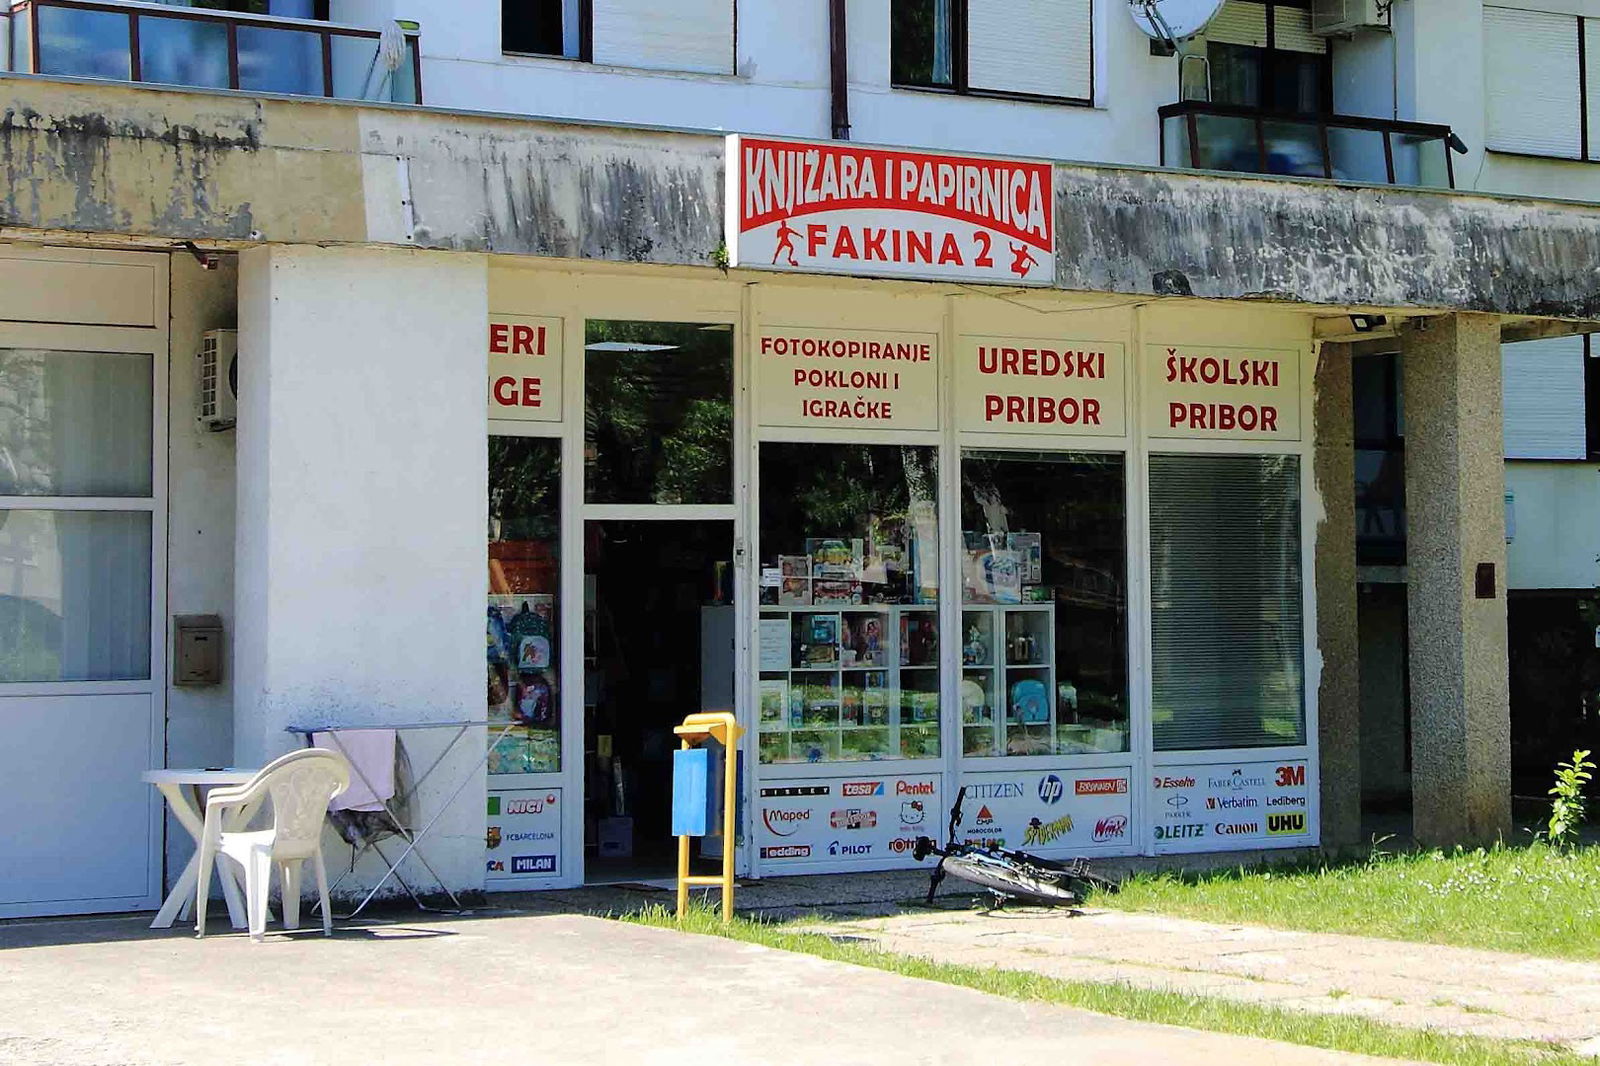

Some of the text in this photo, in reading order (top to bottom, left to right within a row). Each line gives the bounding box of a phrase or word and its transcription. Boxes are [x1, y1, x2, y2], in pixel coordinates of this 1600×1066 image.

[746, 147, 1048, 240] KNJIŽARA I PAPIRNICA
[807, 224, 993, 268] FAKINA 2
[489, 324, 546, 355] ERI
[761, 337, 931, 363] FOTOKOPIRANJE
[978, 347, 1105, 378] UREDSKI
[1166, 348, 1279, 387] ŠKOLSKI
[794, 369, 899, 389] POKLONI I
[488, 375, 541, 407] GE
[802, 395, 892, 419] IGRAČKE
[985, 395, 1101, 424] PRIBOR
[1169, 402, 1278, 432] PRIBOR
[1163, 776, 1196, 788] Esselte
[1275, 766, 1305, 787] 3M
[761, 787, 828, 796] SISLEY
[845, 784, 872, 795] tesa
[896, 780, 935, 795] Pentel
[965, 783, 1024, 799] CITIZEN
[1040, 775, 1062, 806] hp
[508, 800, 543, 814] NICI
[1217, 796, 1258, 810] Verbatim
[1266, 796, 1306, 807] Lediberg
[769, 808, 810, 823] Maped
[1268, 814, 1304, 832] UHU
[1165, 824, 1204, 838] LEITZ
[1215, 822, 1258, 834] Canon
[769, 847, 809, 857] edding
[841, 845, 873, 855] PILOT
[516, 858, 552, 870] MILAN
